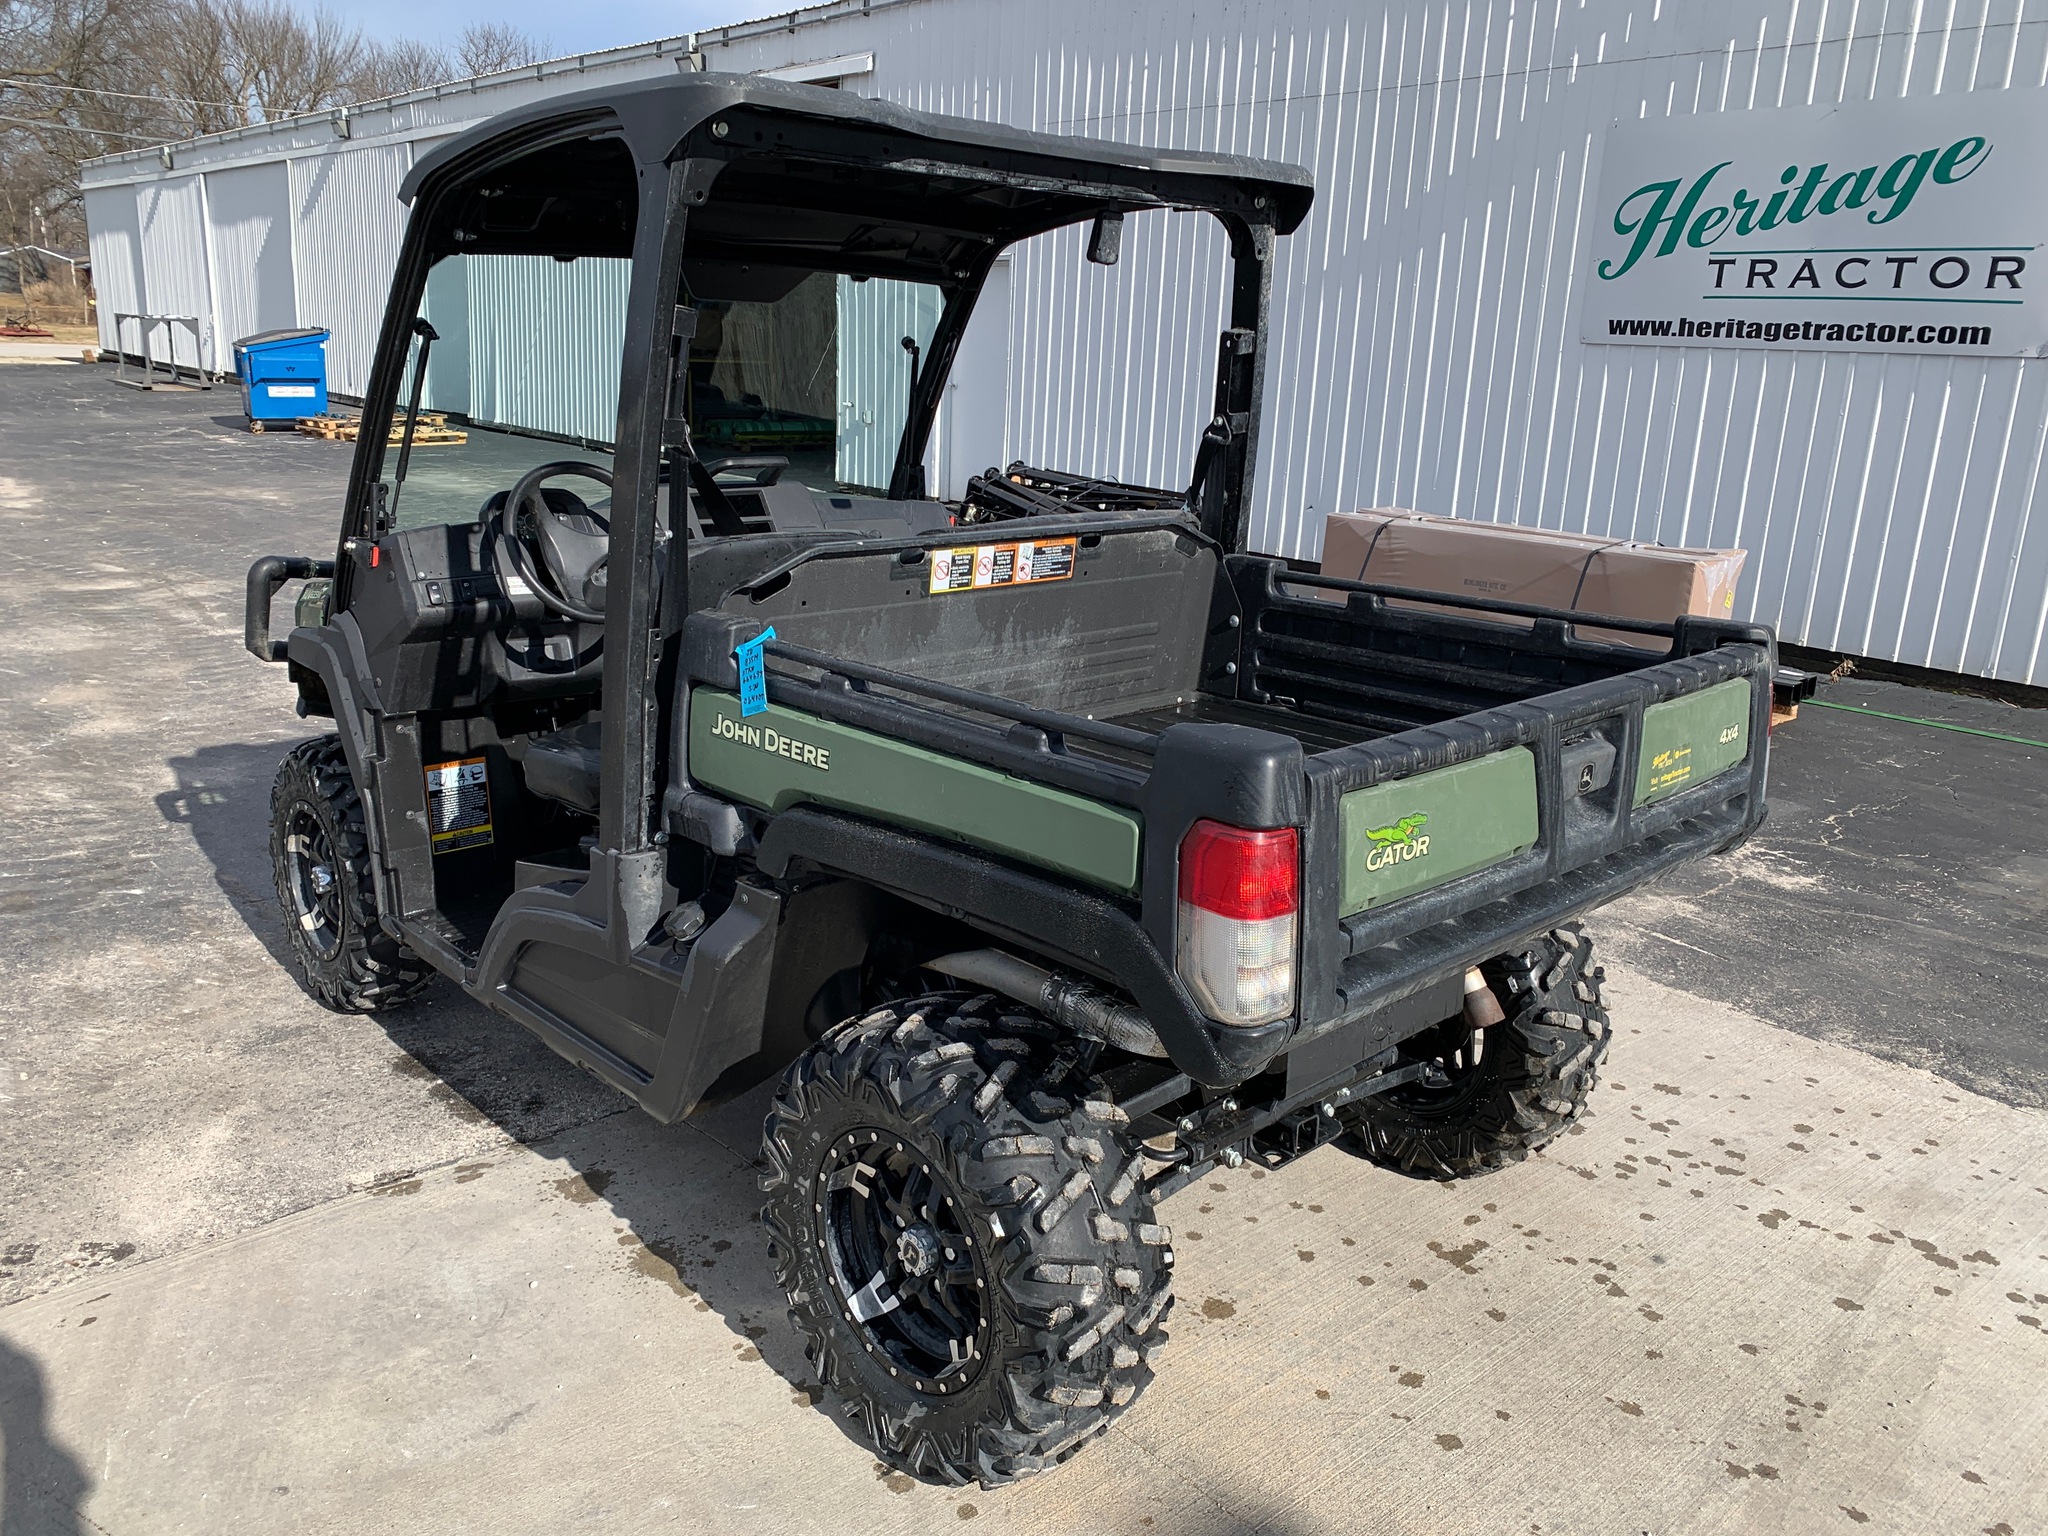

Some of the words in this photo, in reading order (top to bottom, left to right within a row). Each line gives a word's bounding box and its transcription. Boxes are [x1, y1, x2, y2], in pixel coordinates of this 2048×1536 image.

[1599, 136, 1994, 280] Heritage
[1707, 256, 2027, 290] TRACTOR
[1608, 317, 1992, 346] www.heritagetractor.com
[711, 712, 760, 748] JOHN
[764, 727, 830, 770] DEERE
[1366, 835, 1431, 872] GATOR
